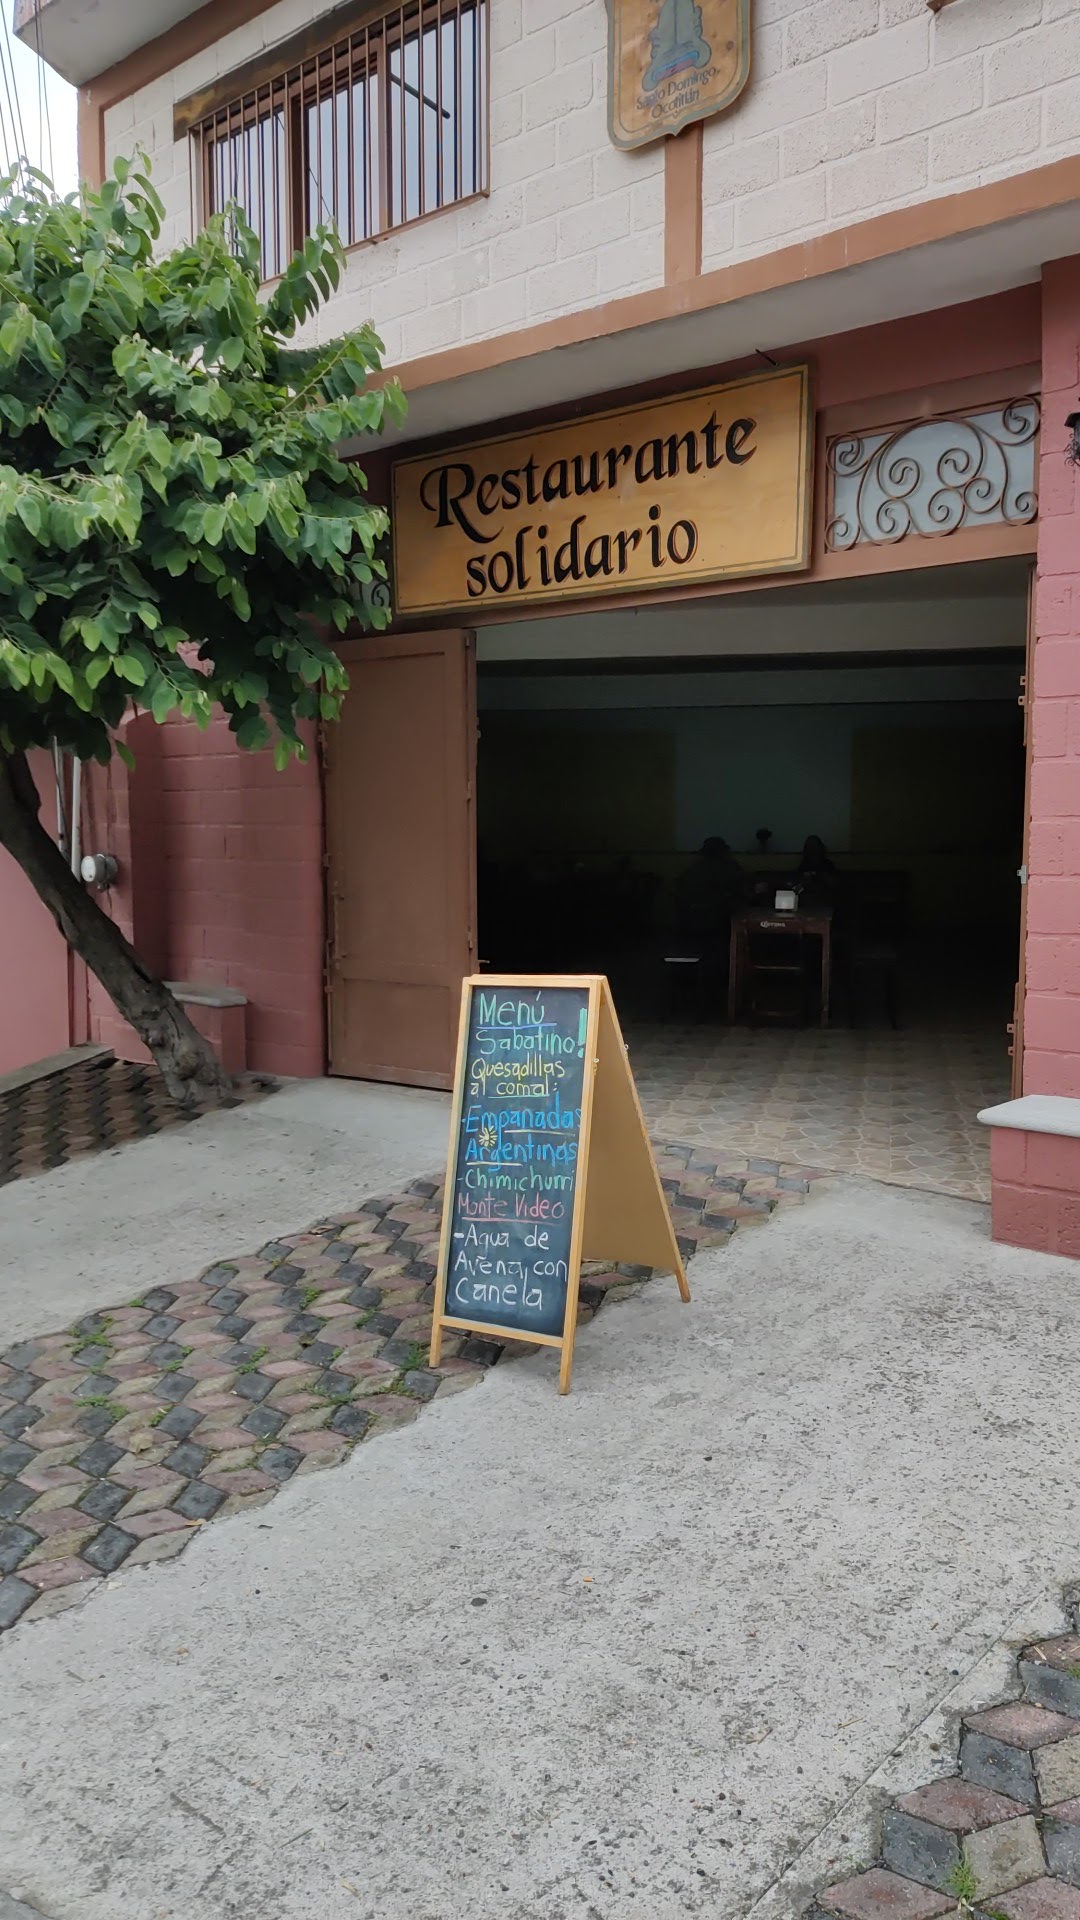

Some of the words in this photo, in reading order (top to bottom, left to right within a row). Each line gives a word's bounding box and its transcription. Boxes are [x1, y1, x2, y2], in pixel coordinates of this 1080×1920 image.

[419, 410, 758, 544] Restaurante
[466, 503, 698, 598] solidario
[479, 990, 545, 1026] Menú
[471, 1051, 566, 1081] Quesadillas
[470, 1074, 486, 1097] al
[458, 1190, 508, 1218] Monte
[515, 1191, 565, 1219] Video
[524, 1224, 549, 1250] de
[533, 1259, 568, 1282] con
[455, 1267, 542, 1311] Canela
